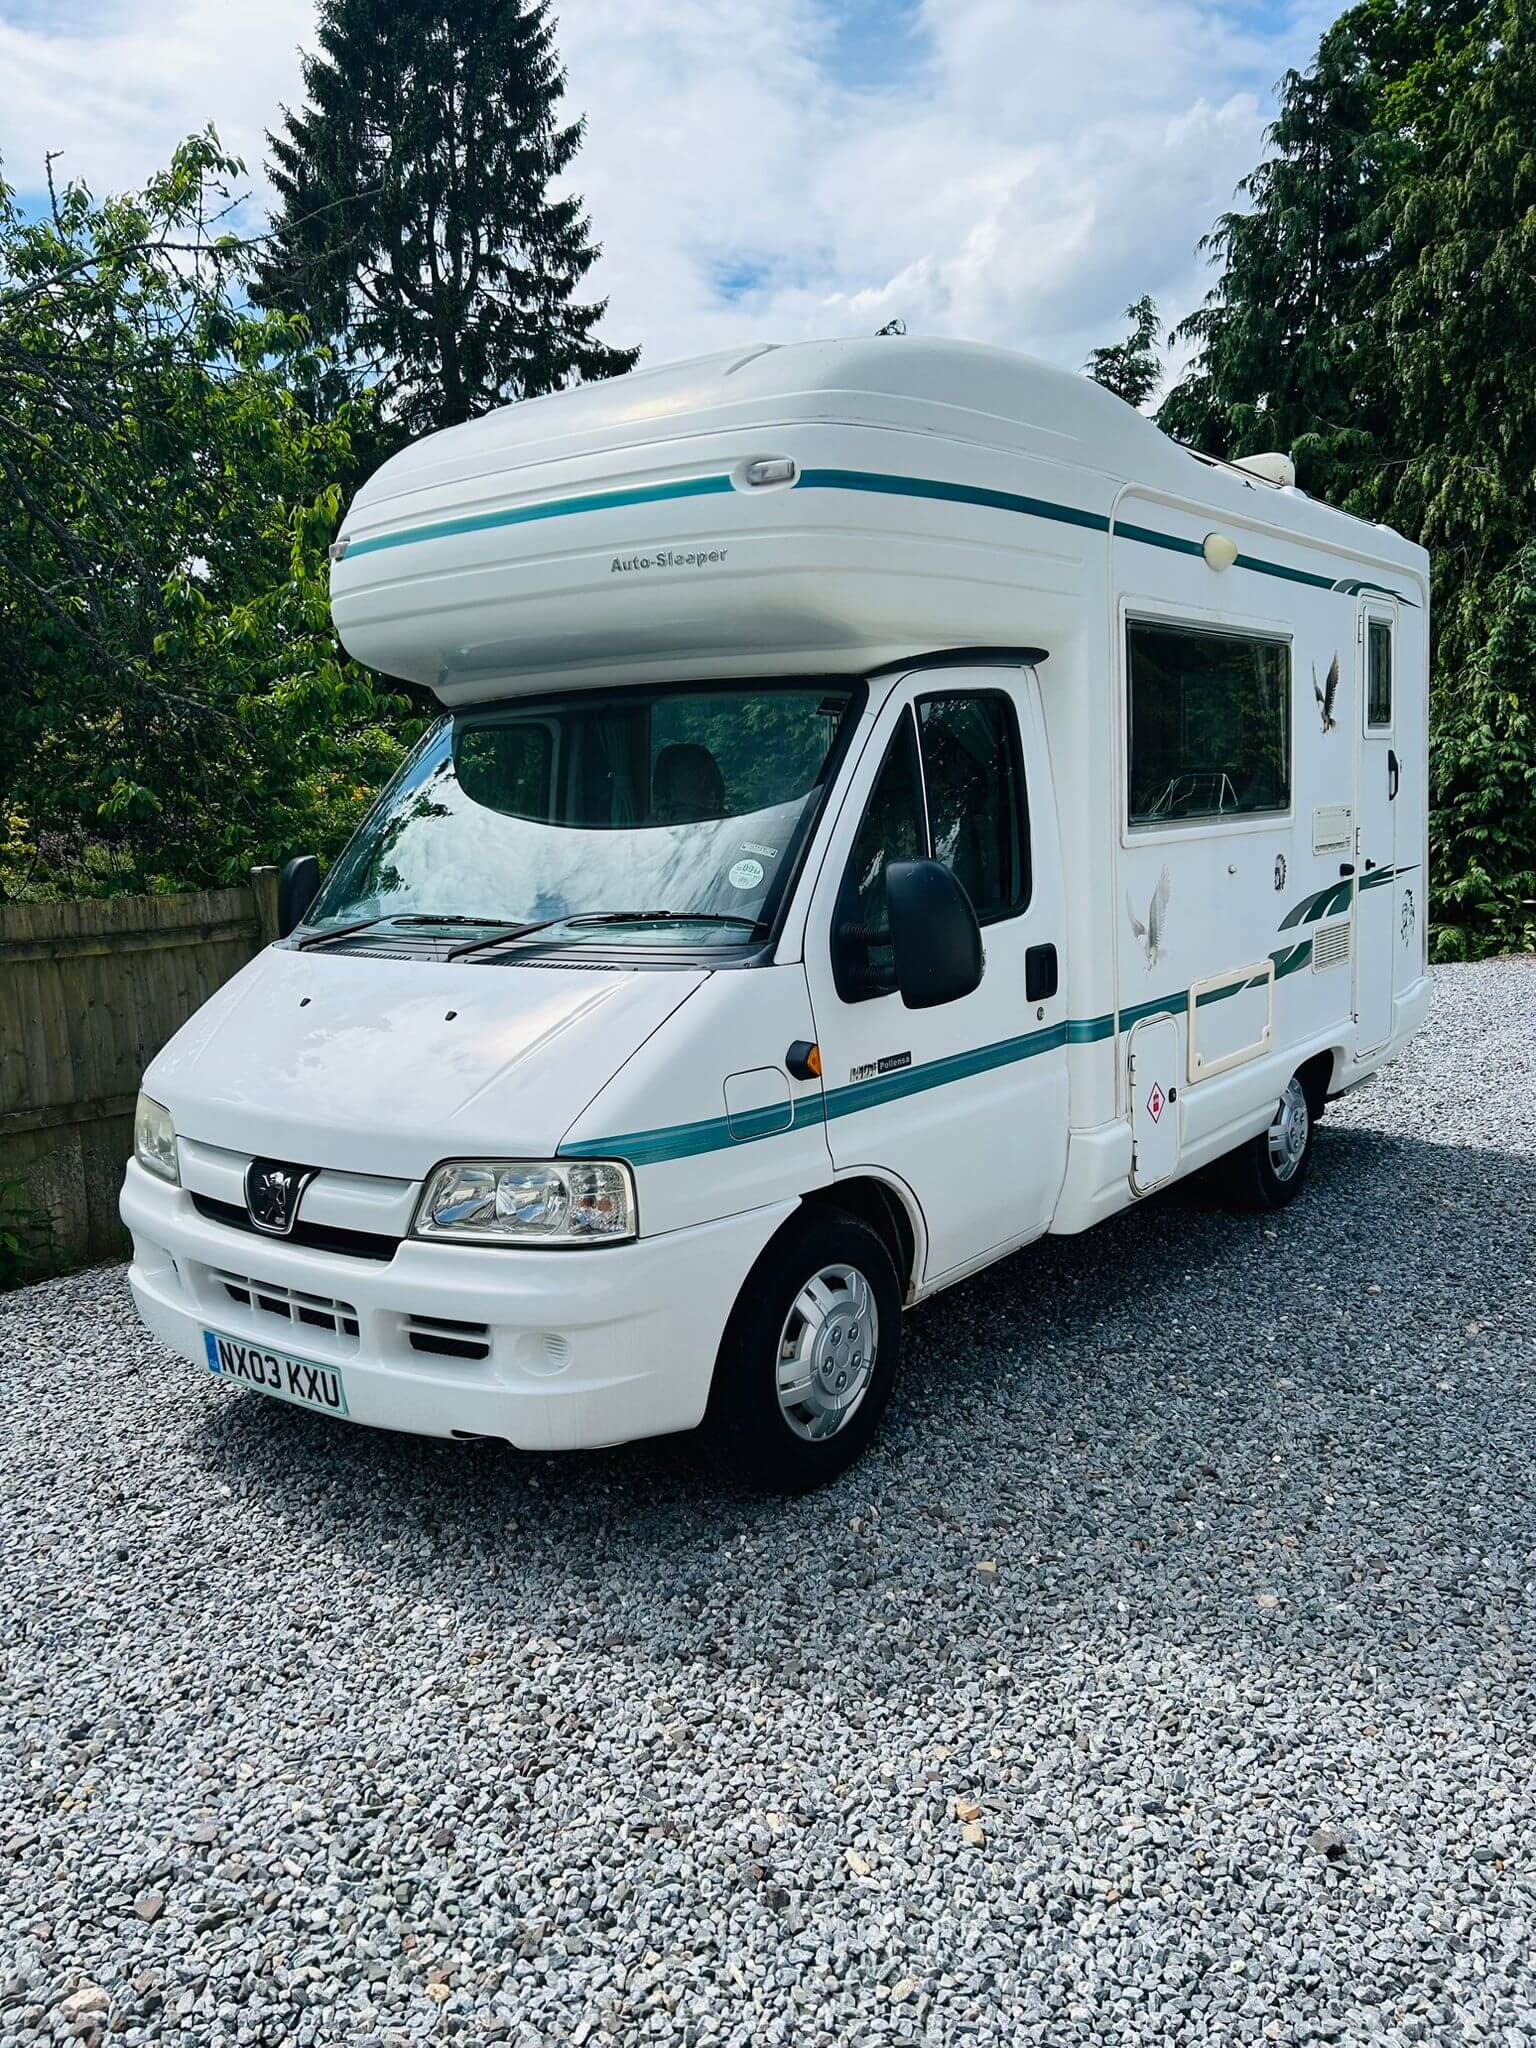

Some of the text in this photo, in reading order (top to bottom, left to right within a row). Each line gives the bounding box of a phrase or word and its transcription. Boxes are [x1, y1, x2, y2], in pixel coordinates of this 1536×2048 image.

[611, 549, 728, 573] Auto-Sleeper
[879, 1056, 910, 1070] Pollensa
[218, 1339, 340, 1407] NX03 KXU
